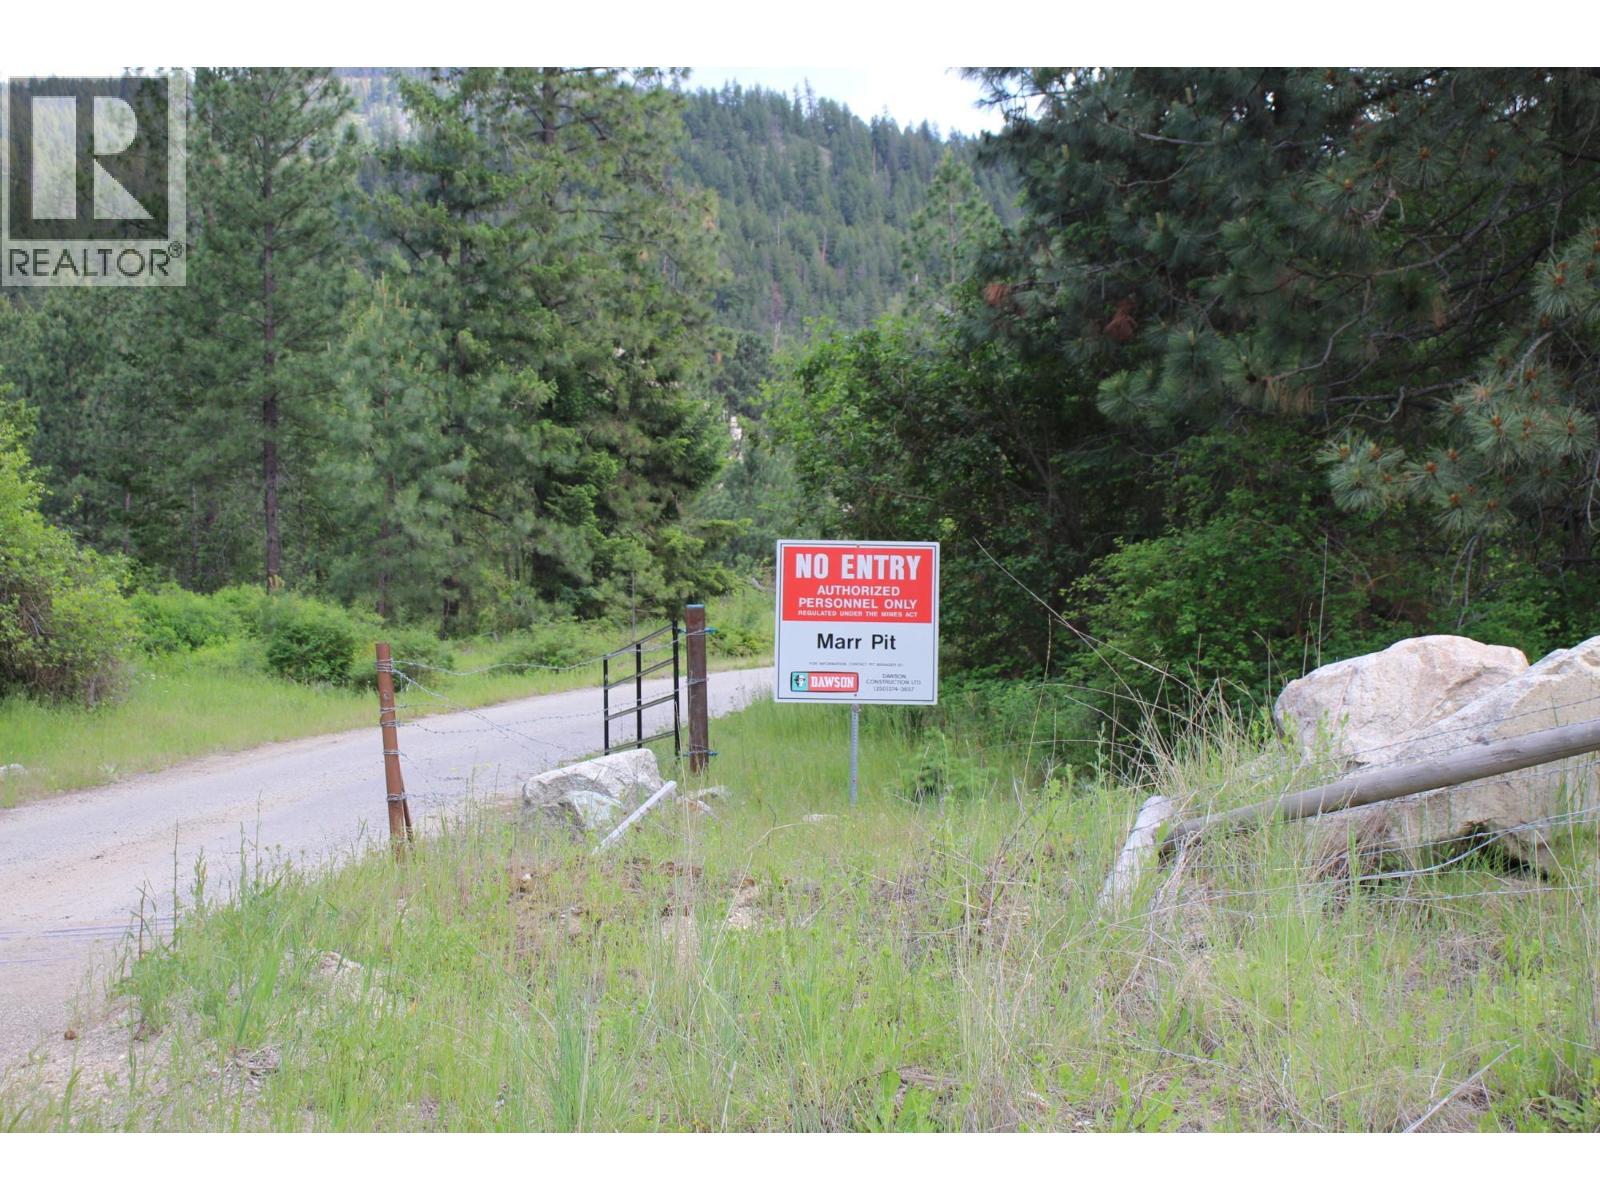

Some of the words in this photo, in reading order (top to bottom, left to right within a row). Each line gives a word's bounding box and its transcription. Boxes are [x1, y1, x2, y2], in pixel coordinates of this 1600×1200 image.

[796, 553, 829, 580] NO
[841, 554, 921, 580] ENTRY
[816, 585, 900, 596] AUTHORIZED
[798, 598, 878, 608] PERSONNEL
[884, 599, 918, 610] ONLY
[816, 633, 862, 650] Marr
[872, 634, 896, 650] Pit
[810, 676, 854, 688] DAWSON
